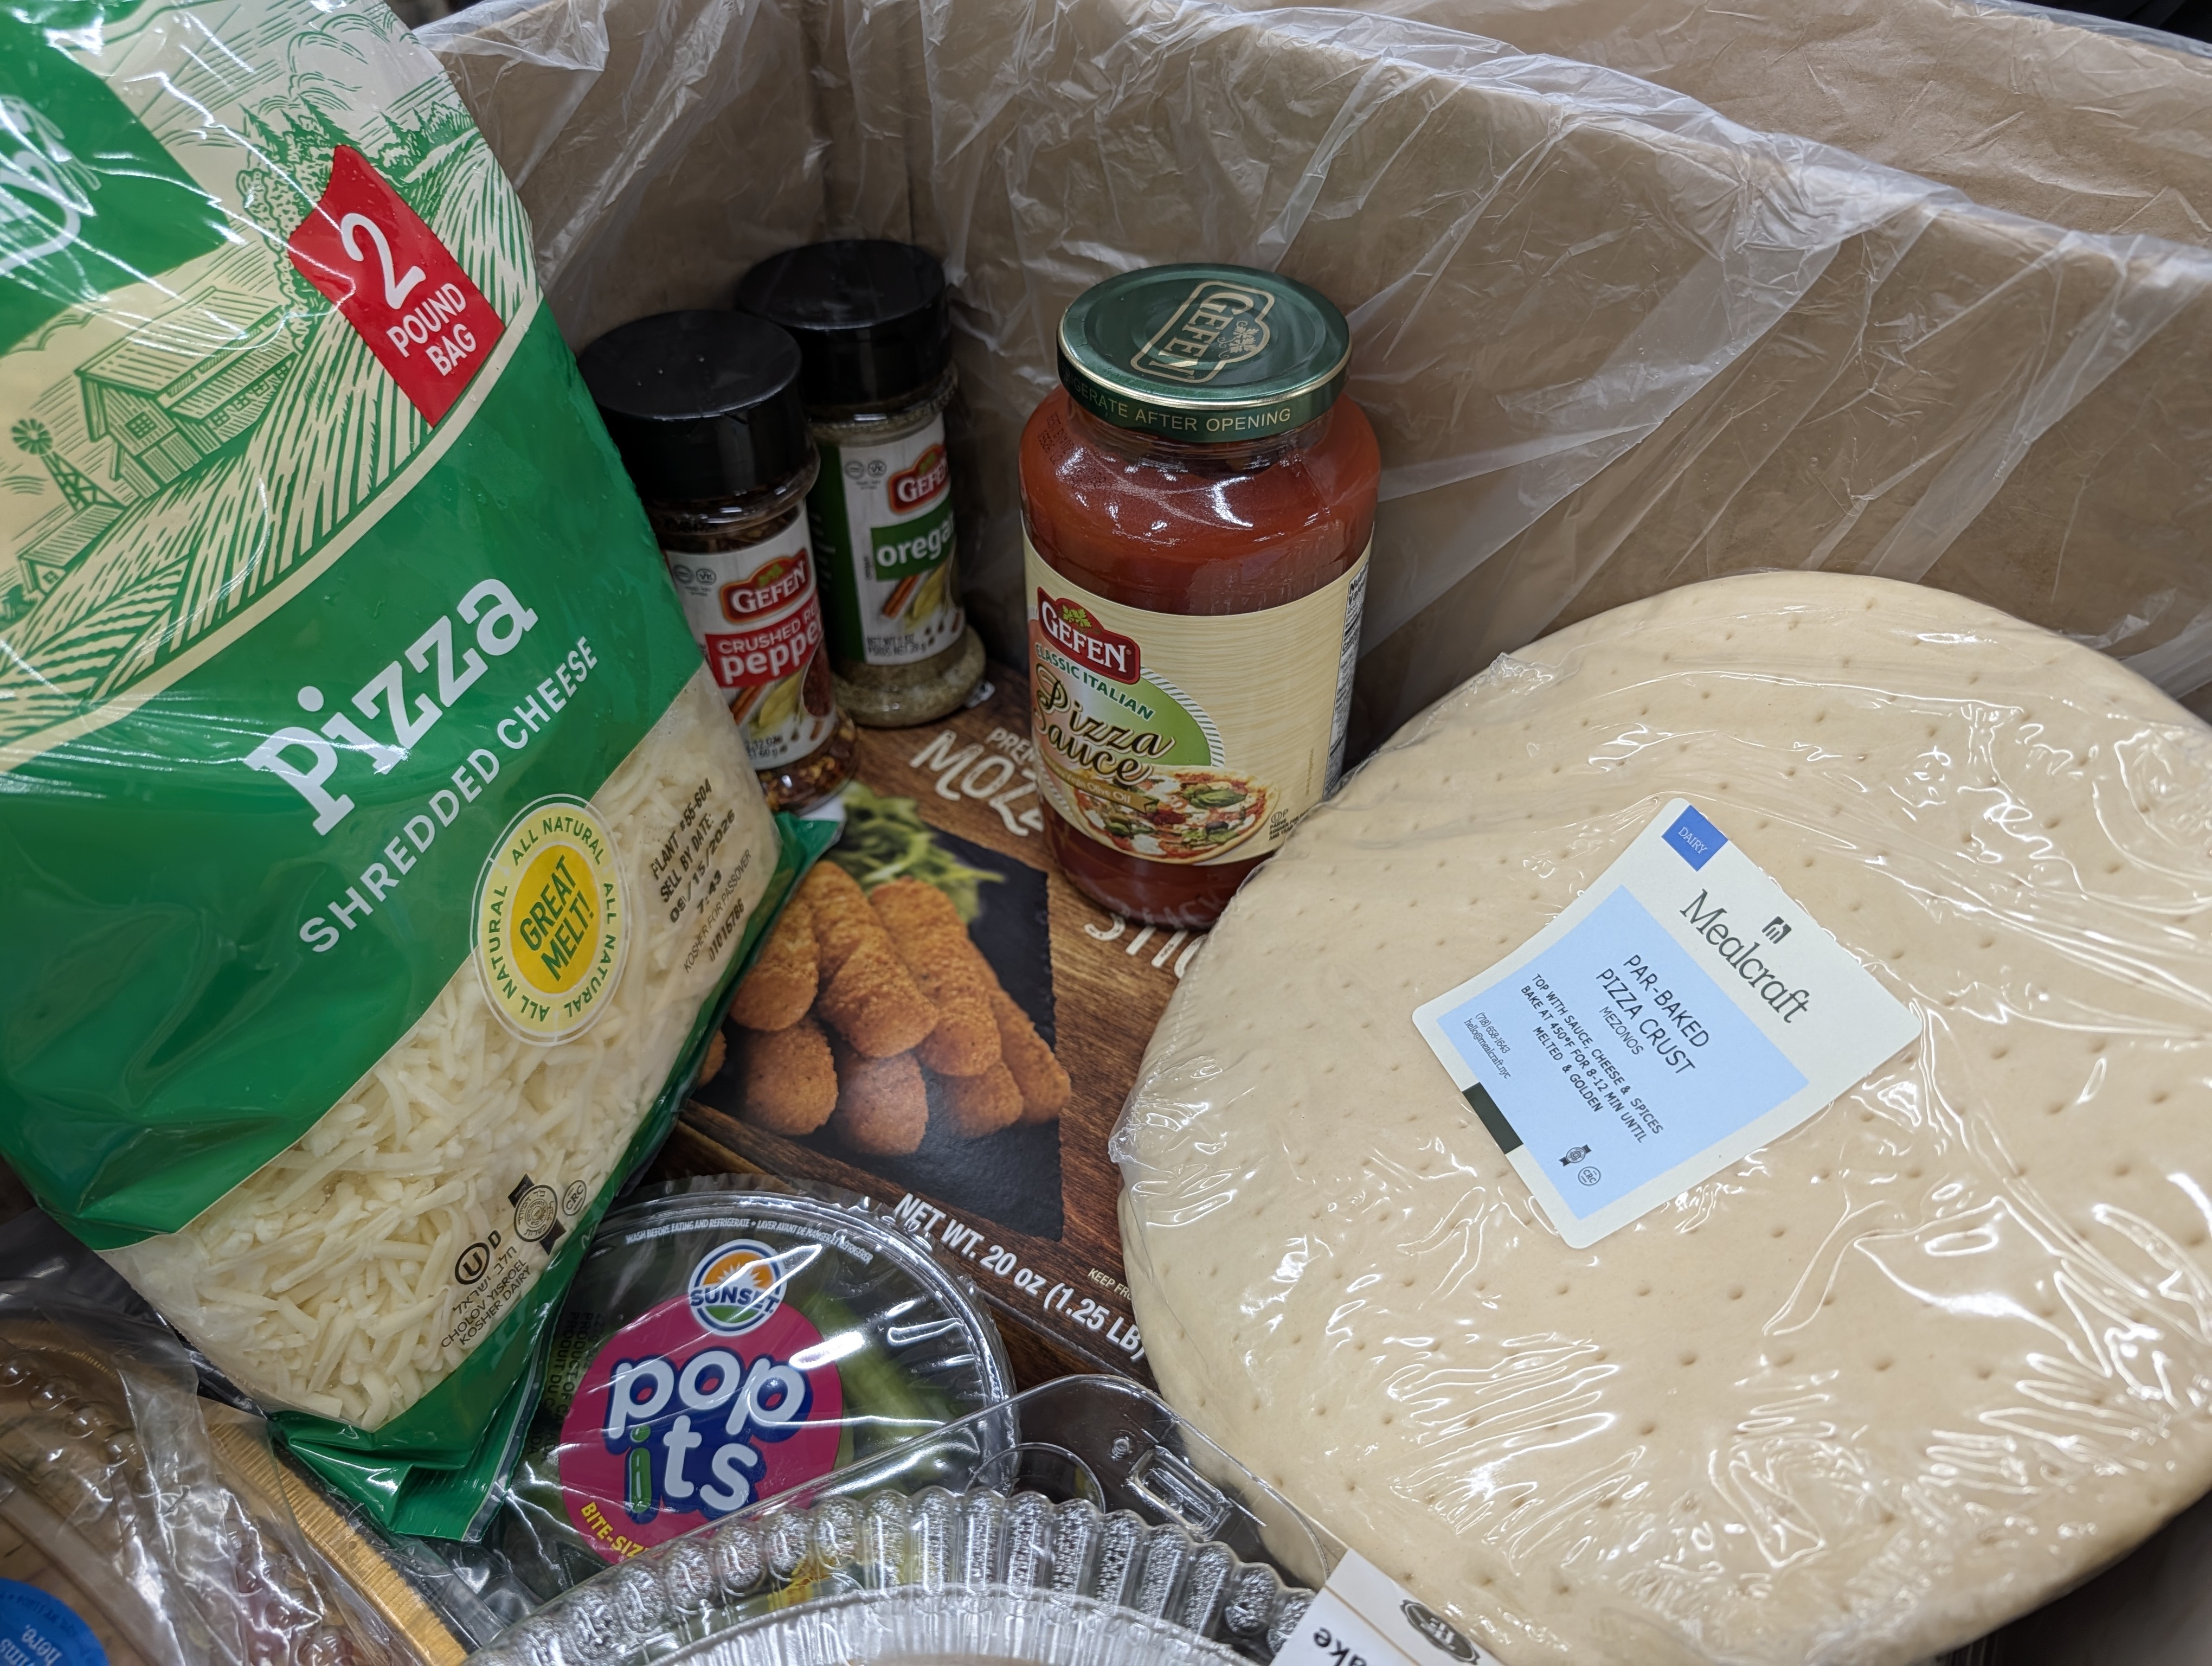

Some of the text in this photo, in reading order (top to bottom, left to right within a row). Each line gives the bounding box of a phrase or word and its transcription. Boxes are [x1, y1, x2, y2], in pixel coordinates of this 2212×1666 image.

[340, 213, 426, 310] 2
[387, 283, 467, 358] POUND
[426, 324, 477, 376] BAG
[1148, 292, 1253, 379] GEFEN
[1062, 367, 1291, 432] RIGERATE AFTER OPENING
[732, 560, 806, 613] GEFEN
[718, 618, 801, 654] CRUSHED
[1042, 601, 1128, 672] GEFEN
[243, 579, 538, 836] pizza
[1035, 662, 1175, 758] Pizza
[1036, 643, 1154, 721] CLASSIC ITALIAN
[1033, 691, 1154, 784] Sauce
[300, 636, 597, 952] SHREDDED CHEESE
[1086, 783, 1111, 797] Olive
[1113, 791, 1131, 804] Oil
[512, 817, 606, 866] ALL NATURAL
[651, 831, 679, 881] PLANT
[660, 812, 715, 903] SELL BY DATE:
[1678, 826, 1708, 855] DAIRY
[520, 855, 575, 952] GREAT
[541, 890, 594, 982] MELT!
[684, 848, 751, 973] KOSHER FOR PASSOVER
[490, 884, 550, 1022] ALL NATURAL
[564, 882, 618, 1019] ALL NATURAL
[1679, 888, 1810, 1023] Mealcraft
[1475, 1012, 1510, 1054] (718) 658-1643
[1596, 968, 1696, 1074] PIZZA CRUST
[1599, 1006, 1644, 1055] MEZONOS
[1623, 954, 1709, 1047] PAR-BAKED
[1464, 1018, 1511, 1079] hello@mealcraft.nyc
[1521, 985, 1544, 1010] BAKE
[1538, 1009, 1554, 1021] AT
[1570, 1048, 1590, 1069] FOR
[1586, 1068, 1609, 1092] 8-12
[1604, 1092, 1625, 1112] MIN
[1621, 1112, 1647, 1143] UNTIL
[1532, 973, 1663, 1134] TOP WITH SAUCE, CHEESE & SPICES
[1533, 1026, 1564, 1061] MELTED
[1562, 1064, 1572, 1074] &
[1570, 1073, 1603, 1112] GOLDEN
[565, 1184, 584, 1210] CRC
[1583, 1169, 1597, 1183] CRC
[488, 1230, 501, 1250] D
[625, 1232, 646, 1245] WASH
[647, 1225, 671, 1239] BEFORE
[671, 1221, 695, 1232] EATING
[695, 1219, 709, 1229] AND
[709, 1218, 751, 1228] REFRIGERATE
[757, 1220, 777, 1230] LAVER
[776, 1222, 798, 1234] AVANT
[798, 1226, 807, 1236] DE
[894, 1193, 946, 1233] NET
[941, 1220, 985, 1260] WT.
[980, 1245, 1018, 1277] 20
[1043, 1283, 1110, 1332] (1.25
[441, 1259, 527, 1348] CHOLOV YISROEL
[452, 1245, 517, 1315] חלב ישראל
[459, 1266, 532, 1345] KOSHER DAIRY
[690, 1286, 781, 1312] SUNSET
[1088, 1267, 1115, 1289] KEEP
[554, 1311, 580, 1372] PRODUIT
[568, 1312, 594, 1379] PRODUCT
[548, 1374, 562, 1394] DU
[560, 1381, 575, 1401] OF
[608, 1350, 806, 1439] pop
[629, 1415, 758, 1513] its
[581, 1502, 650, 1558] BITE-SIZ
[21, 1624, 63, 1666] here.
